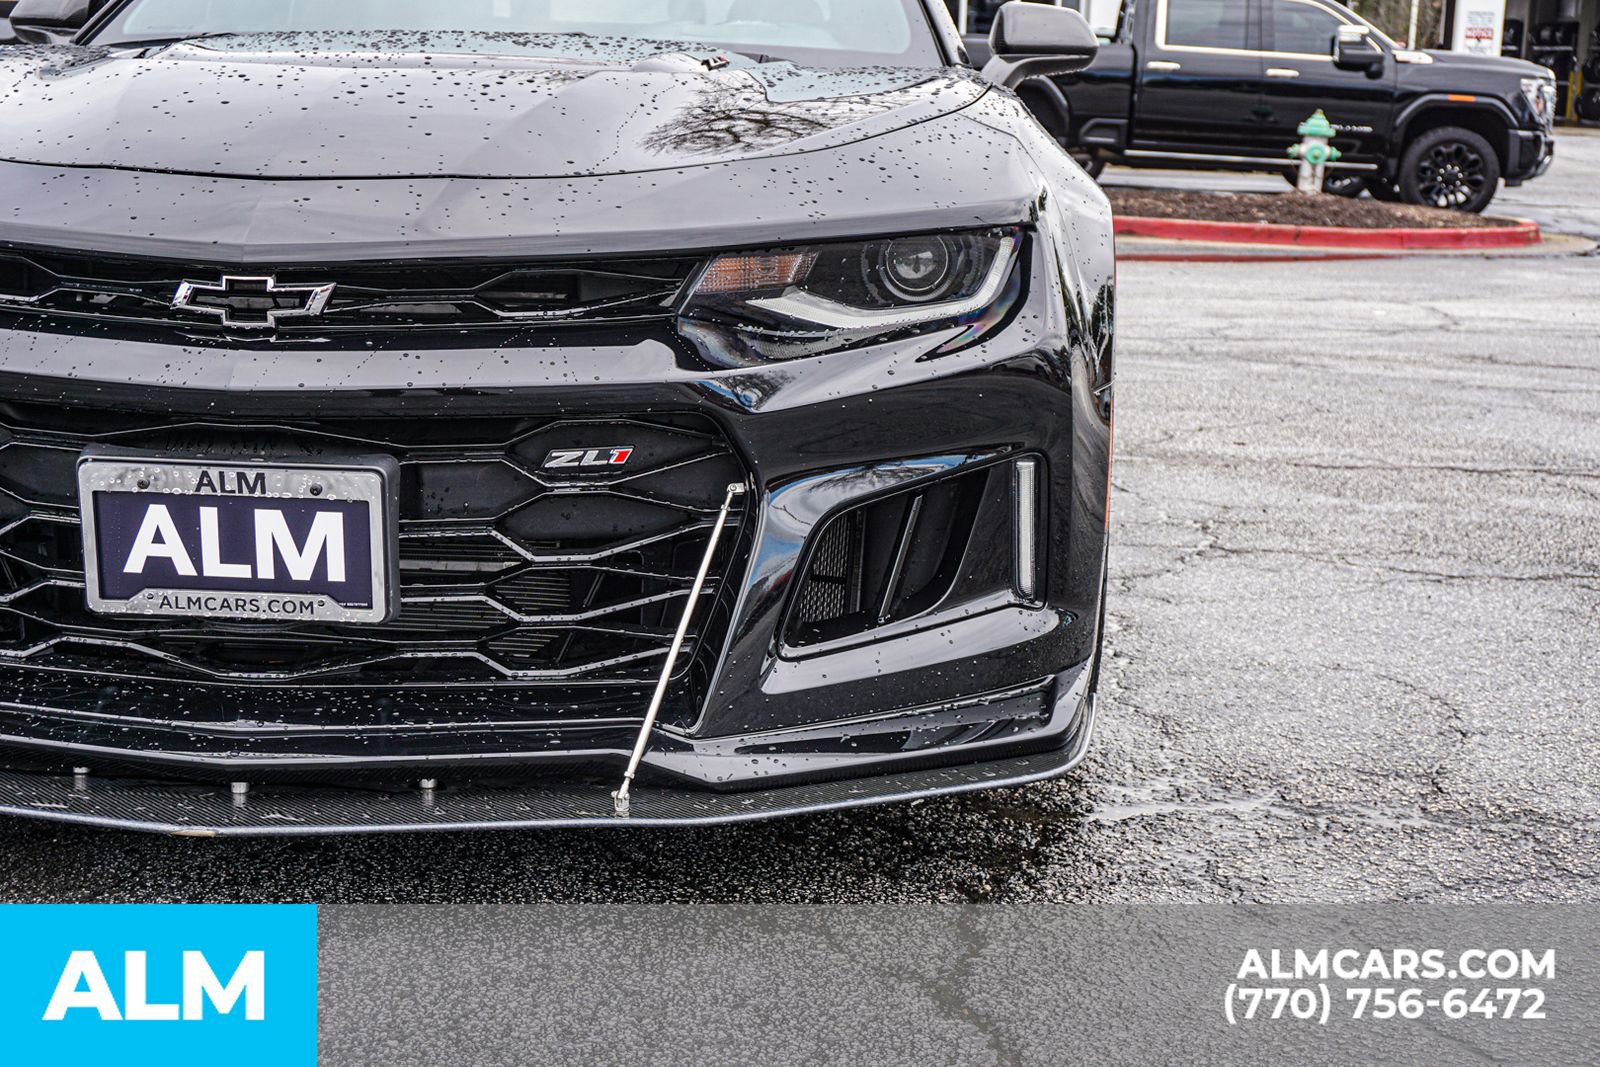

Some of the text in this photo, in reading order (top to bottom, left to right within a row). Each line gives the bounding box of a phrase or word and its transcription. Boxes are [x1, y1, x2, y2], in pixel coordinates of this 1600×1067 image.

[544, 448, 632, 468] ZL1
[194, 470, 267, 495] ALM
[123, 504, 346, 582] ALM
[159, 594, 315, 615] ALMCARS.COM
